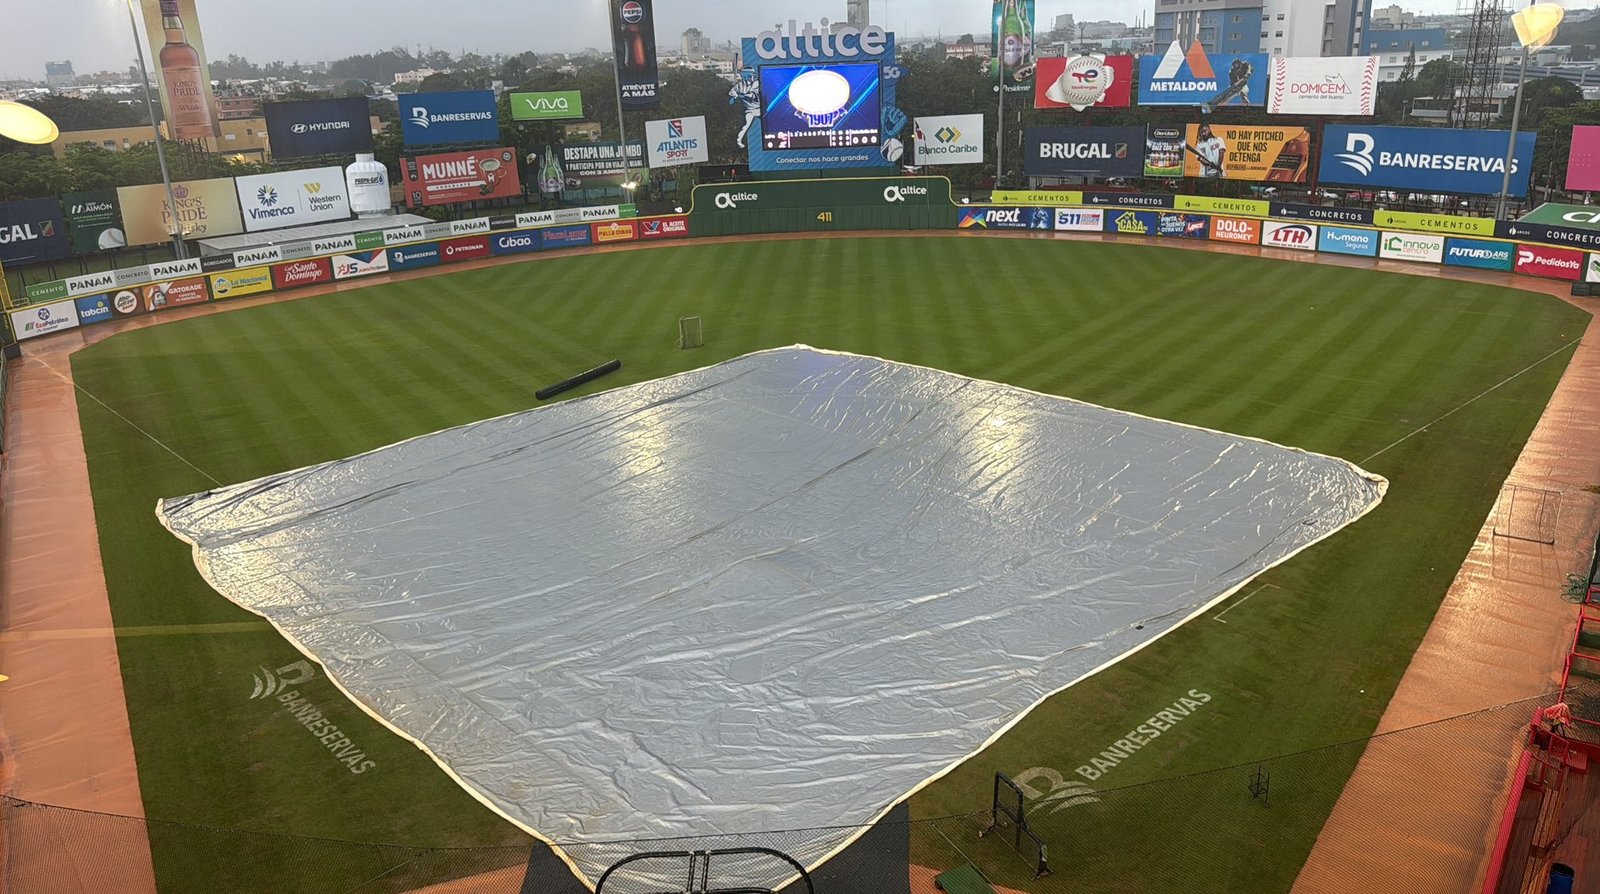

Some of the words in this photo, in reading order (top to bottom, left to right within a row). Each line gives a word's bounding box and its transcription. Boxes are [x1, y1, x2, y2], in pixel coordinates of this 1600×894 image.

[755, 17, 887, 60] altice
[622, 83, 655, 91] ATRÉVETE
[1150, 81, 1217, 92] METALDOM
[1291, 83, 1345, 94] DOMICEM
[431, 111, 492, 123] BANRESERVAS
[309, 120, 350, 132] HYUNDAI
[1226, 130, 1236, 140] NO
[1238, 130, 1251, 140] HAY
[1253, 131, 1284, 142] PITCHEO
[657, 138, 698, 153] ATLANTIS
[918, 146, 947, 155] Banco
[948, 144, 978, 154] Caribe
[1039, 143, 1112, 159] BRUGAL
[1237, 141, 1251, 151] QUE
[1253, 142, 1268, 152] NOS
[564, 146, 598, 160] DESTAPA
[599, 145, 615, 159] UNA
[667, 149, 688, 158] SPORT
[840, 154, 869, 162] grandes
[1229, 151, 1261, 163] DETENGA
[422, 156, 478, 180] MUNNÉ
[1379, 151, 1519, 174] BANRESERVAS
[412, 191, 422, 199] 10
[900, 185, 927, 195] altice
[308, 194, 341, 204] Western
[731, 192, 758, 201] altice
[1118, 197, 1163, 205] CONCRETOS
[161, 197, 202, 211] KNG'S
[309, 203, 333, 212] Union
[1213, 202, 1256, 212] CEMENTOS
[248, 205, 295, 220] Vimenca
[583, 208, 616, 217] PANAM
[817, 212, 832, 222] 411
[986, 207, 1021, 223] next
[1309, 210, 1362, 221] CONCRETOS
[518, 214, 552, 224] PANAM
[1420, 219, 1478, 230] CEMENTOS
[425, 226, 450, 234] CONCRETO
[453, 221, 488, 232] PANAM
[1120, 219, 1144, 231] CASA
[1216, 219, 1252, 232] DOLO-
[357, 236, 383, 244] CEMENTO
[387, 230, 422, 241] PANAM
[1273, 228, 1306, 244] LTH
[314, 239, 353, 251] PANAM
[498, 237, 531, 248] Cibao
[1345, 241, 1368, 250] Seguros
[1403, 240, 1440, 250] innova
[283, 246, 311, 255] CONCRETO
[455, 244, 484, 253] PETRONAN
[1492, 249, 1509, 258] ARS
[237, 250, 278, 263] PANAM
[404, 250, 437, 260] BANRESERVAS
[203, 258, 233, 267] AGREGADOS
[293, 261, 317, 273] Santo
[1534, 256, 1580, 270] PedidosYa
[117, 270, 149, 280] CONCRETO
[154, 263, 198, 276] PANAM
[285, 268, 323, 282] Domingo
[70, 276, 113, 291] PANAM
[239, 275, 268, 284] Nacional
[31, 286, 64, 297] CEMENTO
[168, 283, 203, 294] GATORADE
[81, 305, 109, 318] tabcin
[276, 690, 376, 775] BANRESERVAS
[1074, 688, 1212, 781] BANRESERVAS
